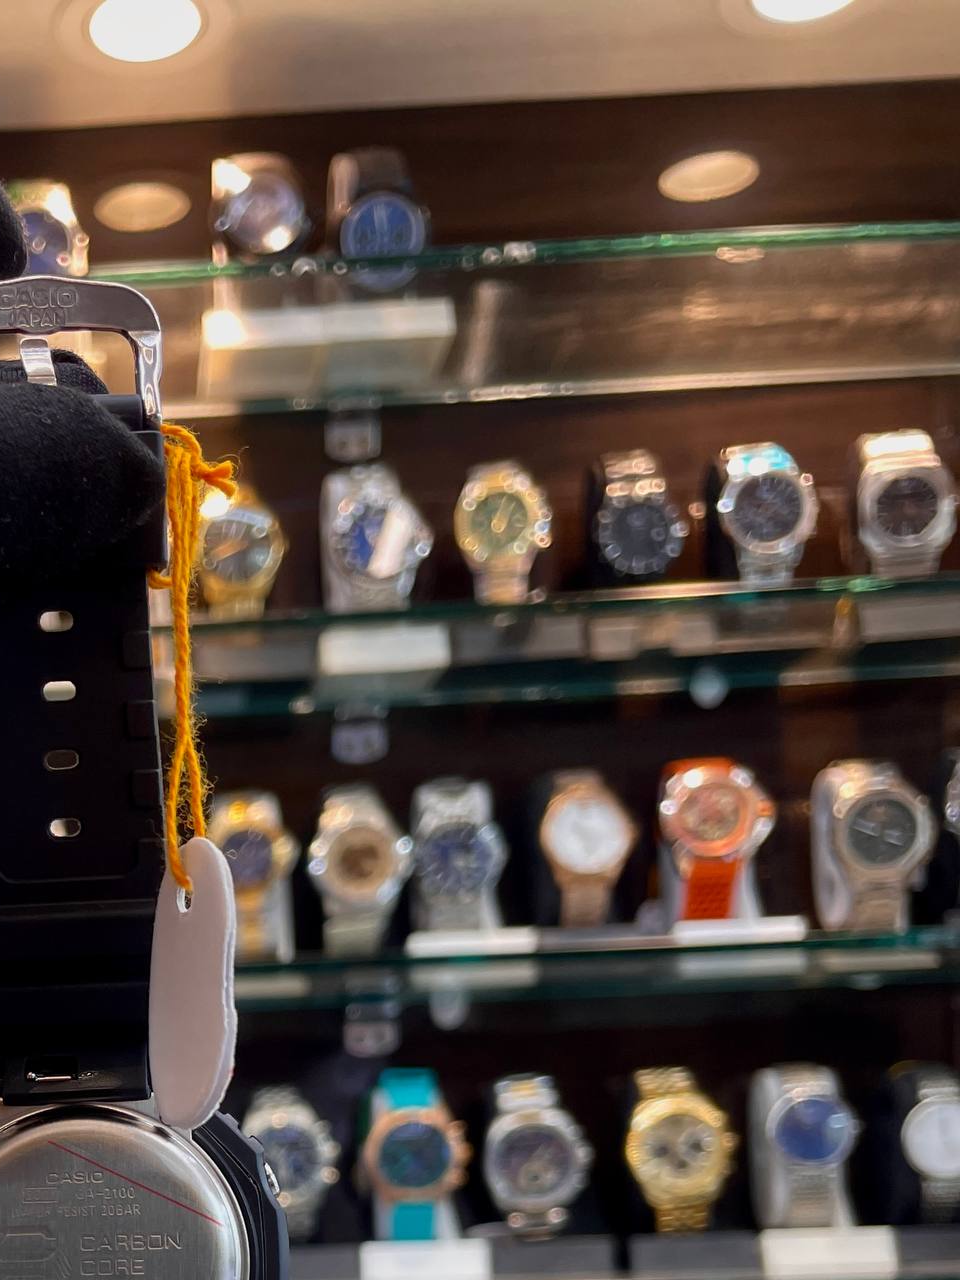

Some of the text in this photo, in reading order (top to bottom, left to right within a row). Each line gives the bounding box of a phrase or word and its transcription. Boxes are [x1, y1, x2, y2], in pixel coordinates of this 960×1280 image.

[8, 308, 66, 328] JAPAN
[46, 1171, 105, 1185] CASIO
[80, 1232, 182, 1251] CARBON
[80, 1259, 145, 1276] CORE
